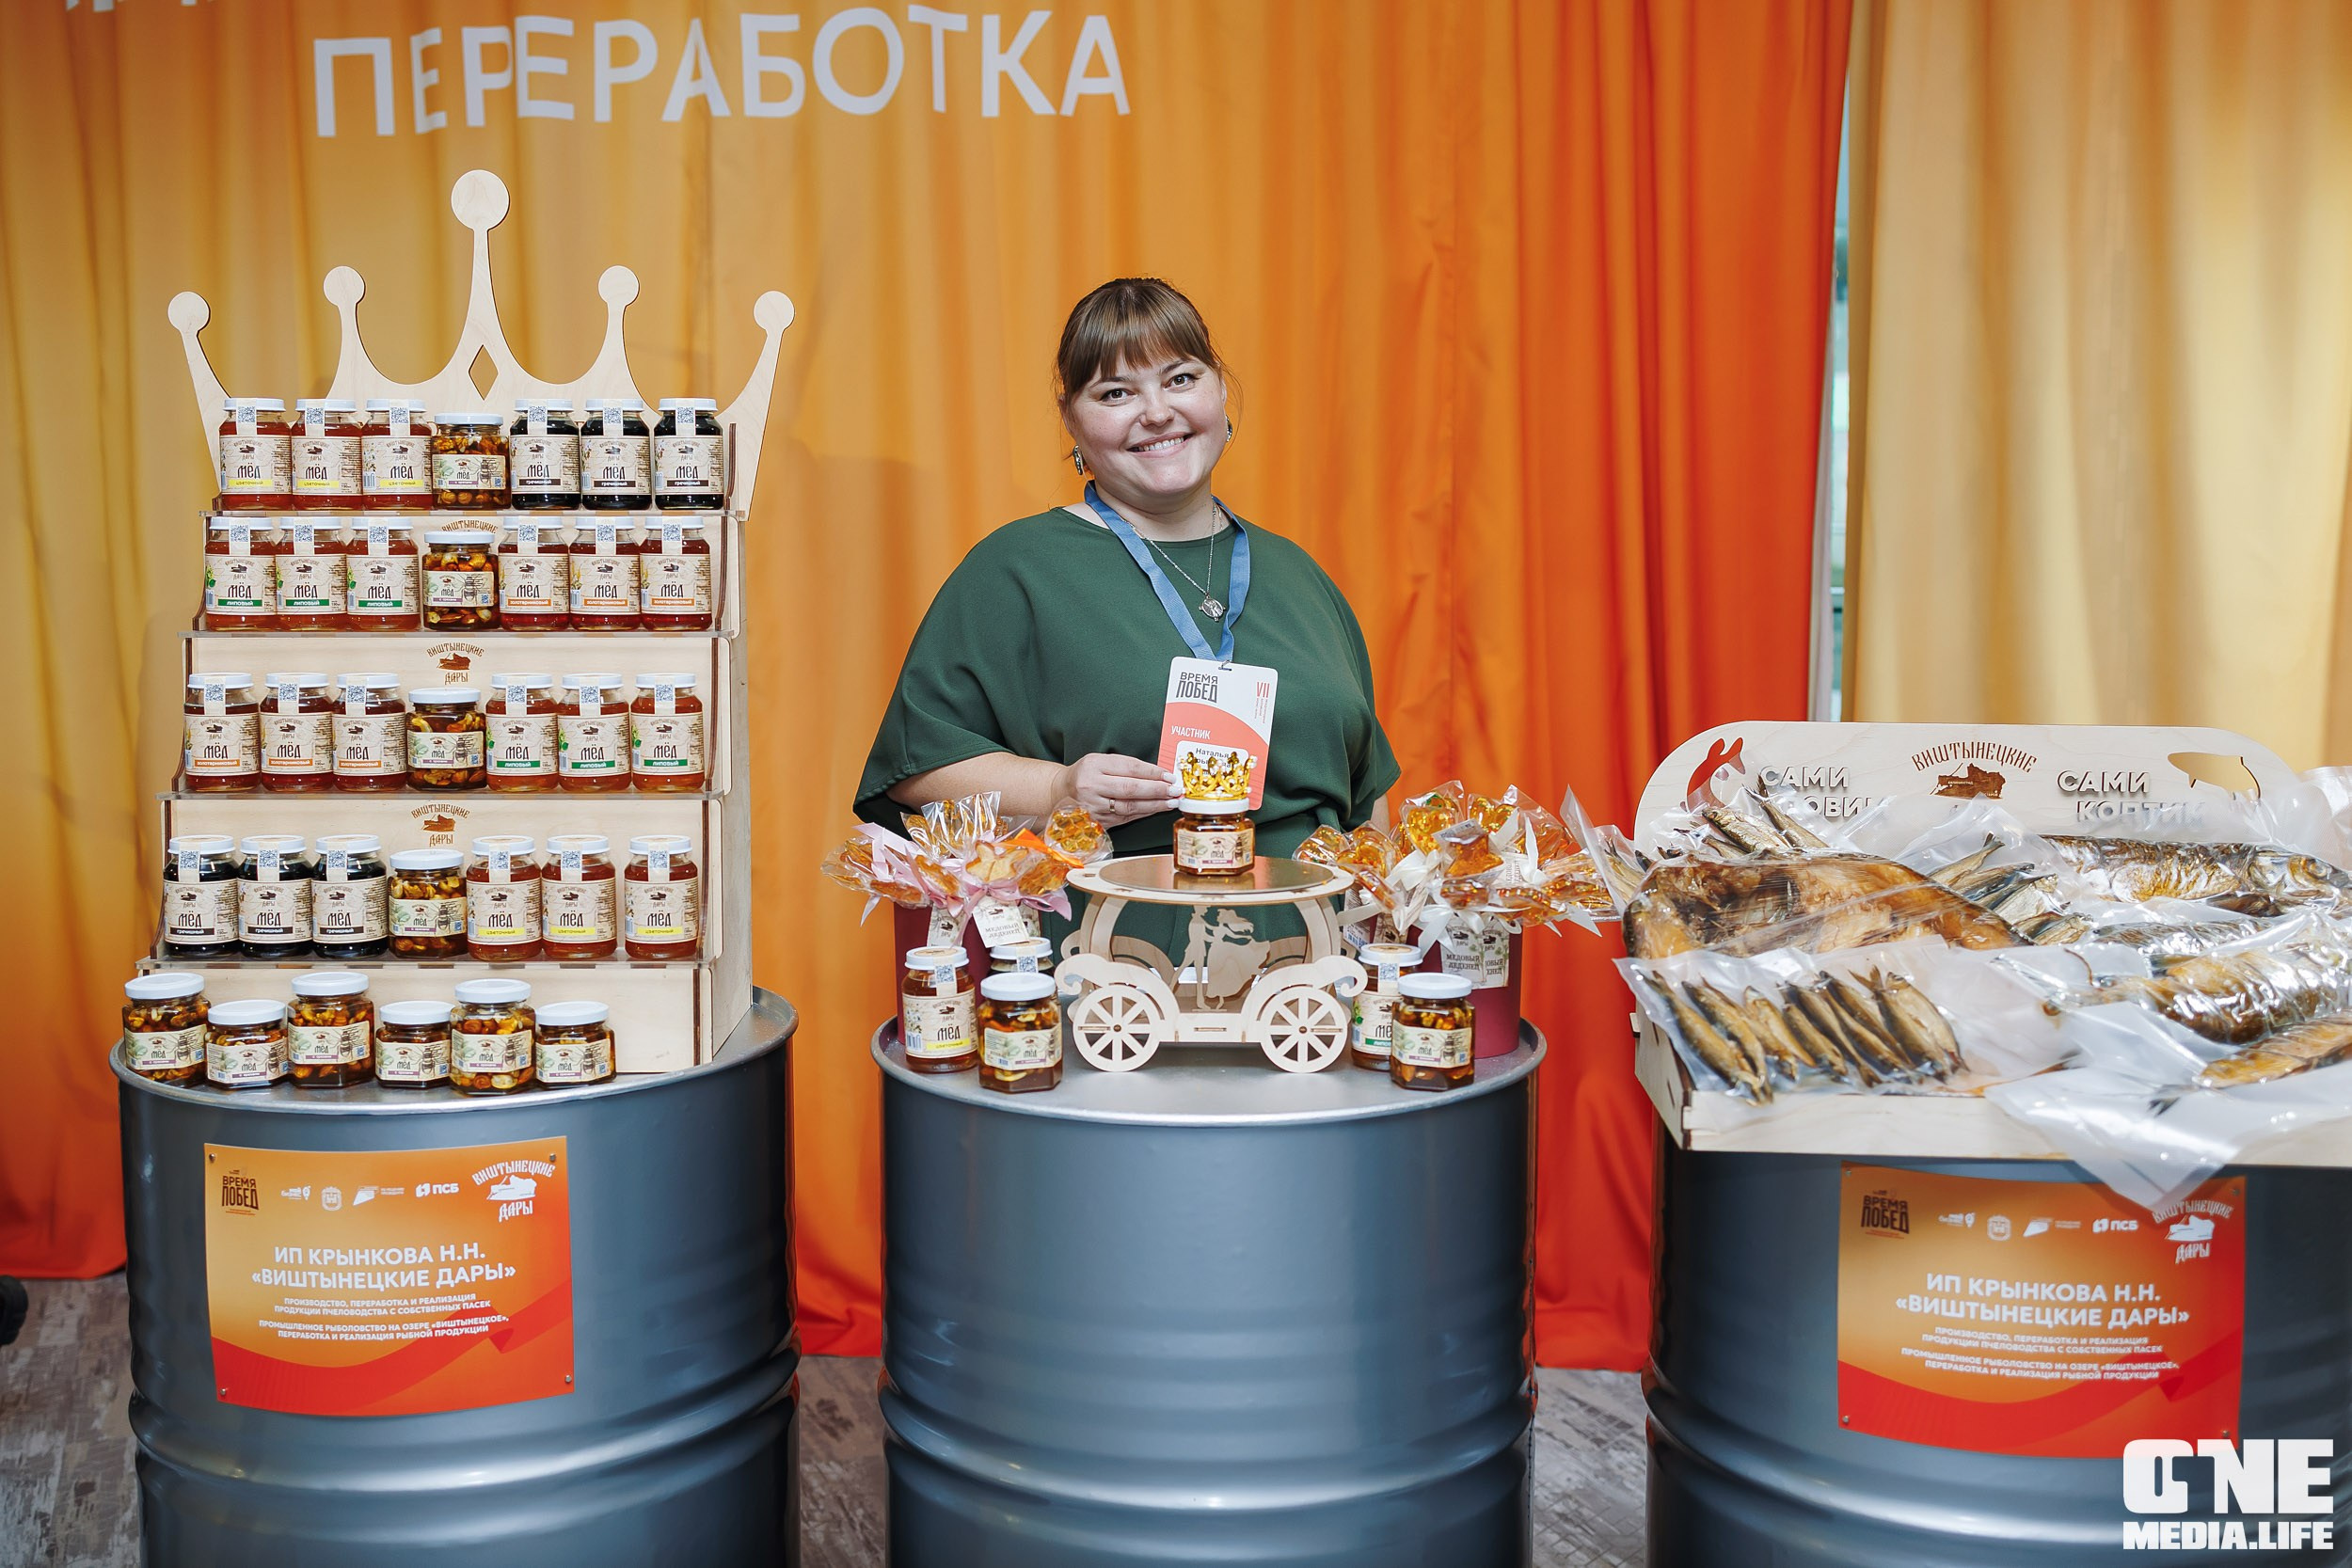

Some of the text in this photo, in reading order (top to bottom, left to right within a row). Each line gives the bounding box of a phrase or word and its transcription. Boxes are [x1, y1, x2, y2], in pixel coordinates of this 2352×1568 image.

[313, 5, 1130, 137] ПЕРЕРАБОТКА
[427, 642, 485, 657] ВИШТЫНЕЦКИЕ
[445, 673, 468, 685] ДАРЫ
[1180, 672, 1218, 685] ВРЕМЯ
[1176, 681, 1217, 704] ПОБЕД
[1171, 725, 1211, 739] УЧАСТНИК
[1912, 742, 2037, 772] ВИШТЫНЕЦКИЕ
[1760, 765, 1851, 787] САМИ
[2058, 770, 2150, 793] САМИ
[411, 803, 469, 818] ВИШТЫНЕЦКИЕ
[429, 834, 453, 847] ДАРЫ
[1375, 1022, 1391, 1037] мё
[471, 1160, 556, 1186] ВИШТЫНЕЦКИЕ
[223, 1176, 257, 1188] ВРЕМЯ
[433, 1183, 459, 1195] ПСБ
[222, 1186, 259, 1211] ПОБЕД
[1864, 1195, 1908, 1210] ВРЕМЯ
[499, 1200, 533, 1223] ДАРЫ
[1861, 1206, 1909, 1234] ПОБЕД
[2110, 1220, 2137, 1231] ПСБ
[275, 1243, 485, 1265] ИП КРЫНКОВА Н.Н.
[252, 1263, 516, 1291] «ВИШТЫНЕЦКИЕ ДАРЫ»
[1927, 1273, 2160, 1302] ИП КРЫНКОВА Н.Н.
[284, 1298, 348, 1307] ПРОИЗВОДСТВО,
[420, 1293, 476, 1305] РЕАЛИЗАЦИЯ
[275, 1306, 321, 1315] ПРОДУКЦИИ
[323, 1307, 388, 1316] ПЧЕЛОВОДСТВА
[398, 1304, 461, 1314] СОБСТВЕННЫХ
[463, 1301, 491, 1309] ПАСЕК
[1896, 1294, 2189, 1329] «ВИШТЫНЕЦКИЕ ДАРЫ»
[260, 1321, 324, 1331] ПРОМЫШЛЕННОЕ
[431, 1315, 509, 1328] «ВИШТЫНЕЦКОЕ»,
[278, 1331, 330, 1339] ПЕРЕРАБОТКА
[396, 1329, 433, 1338] РЫБНОЙ
[435, 1325, 488, 1337] ПРОДУКЦИИ
